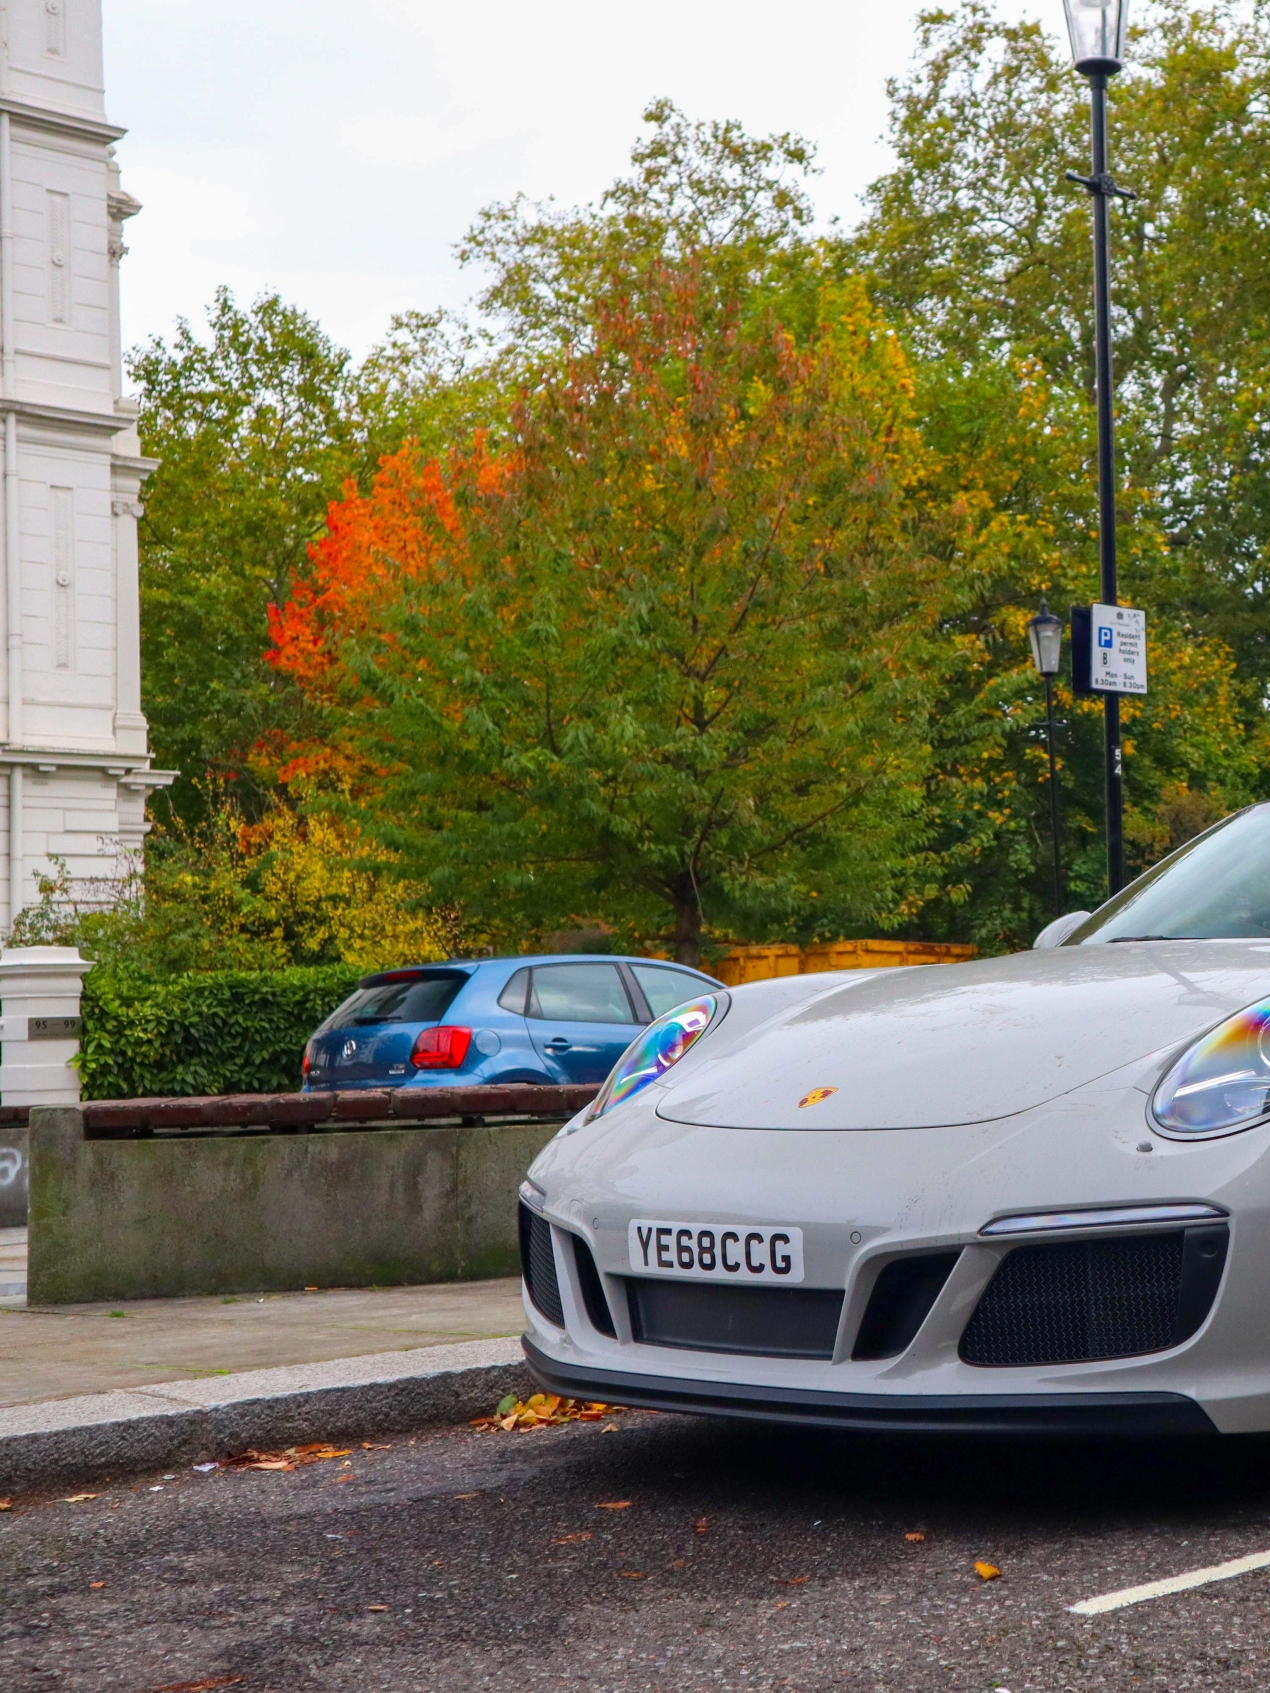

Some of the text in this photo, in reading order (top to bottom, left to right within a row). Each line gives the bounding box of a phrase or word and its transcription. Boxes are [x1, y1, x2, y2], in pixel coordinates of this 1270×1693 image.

[1101, 629, 1111, 646] P
[1117, 631, 1141, 641] Resident
[1120, 640, 1138, 648] permit
[1119, 648, 1139, 656] holders
[1103, 652, 1108, 665] B
[1123, 657, 1136, 665] only
[1095, 678, 1117, 687] 8.30am
[1123, 681, 1145, 690] 8.30pm
[35, 1020, 47, 1030] 95
[64, 1020, 76, 1029] 99
[636, 1226, 792, 1275] YE68CCG
